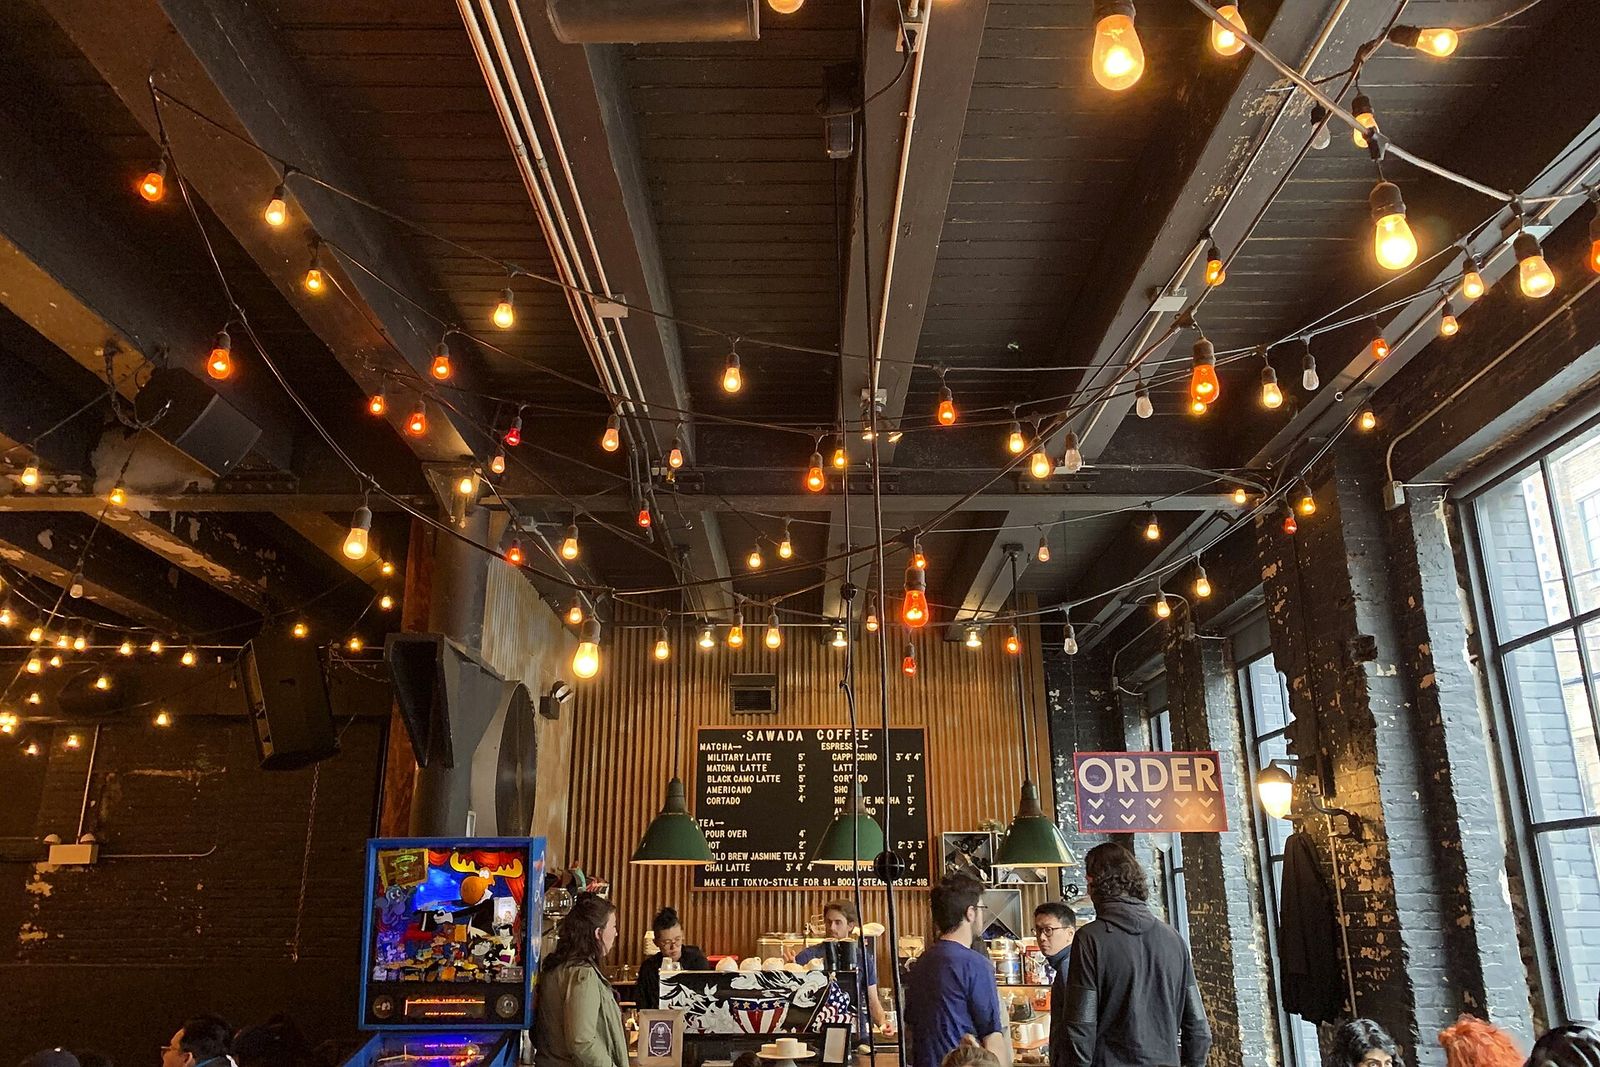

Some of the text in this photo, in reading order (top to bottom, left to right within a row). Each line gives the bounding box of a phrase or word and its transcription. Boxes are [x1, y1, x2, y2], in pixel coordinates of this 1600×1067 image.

[746, 730, 803, 741] SAWADA
[700, 742, 733, 750] MATCHA
[707, 753, 744, 761] MILITARY
[746, 753, 772, 761] LATTE
[706, 764, 736, 772] MATCHA
[740, 764, 768, 772] LATTE
[707, 775, 732, 783] BLACK
[733, 775, 755, 783] CAMO
[756, 775, 781, 783] LATTE
[833, 775, 868, 783] CORTDO
[1078, 757, 1218, 793] ORDER
[706, 785, 752, 794] AMERICANO
[833, 785, 848, 793] SHO
[706, 797, 741, 805] CORTADO
[875, 796, 900, 804] MOHA
[699, 819, 715, 827] TEA
[705, 830, 725, 838] POUR
[727, 830, 748, 838] OVER
[712, 852, 726, 860] OLD
[727, 852, 749, 860] BREW
[750, 852, 781, 860] JASMINE
[783, 852, 797, 860] TEA
[704, 863, 723, 872] CHAI
[725, 863, 751, 872] LATTE
[704, 878, 727, 887] MAKE
[731, 878, 739, 887] IT
[743, 878, 799, 887] TOKYO-STYLE
[803, 878, 819, 887] FOR
